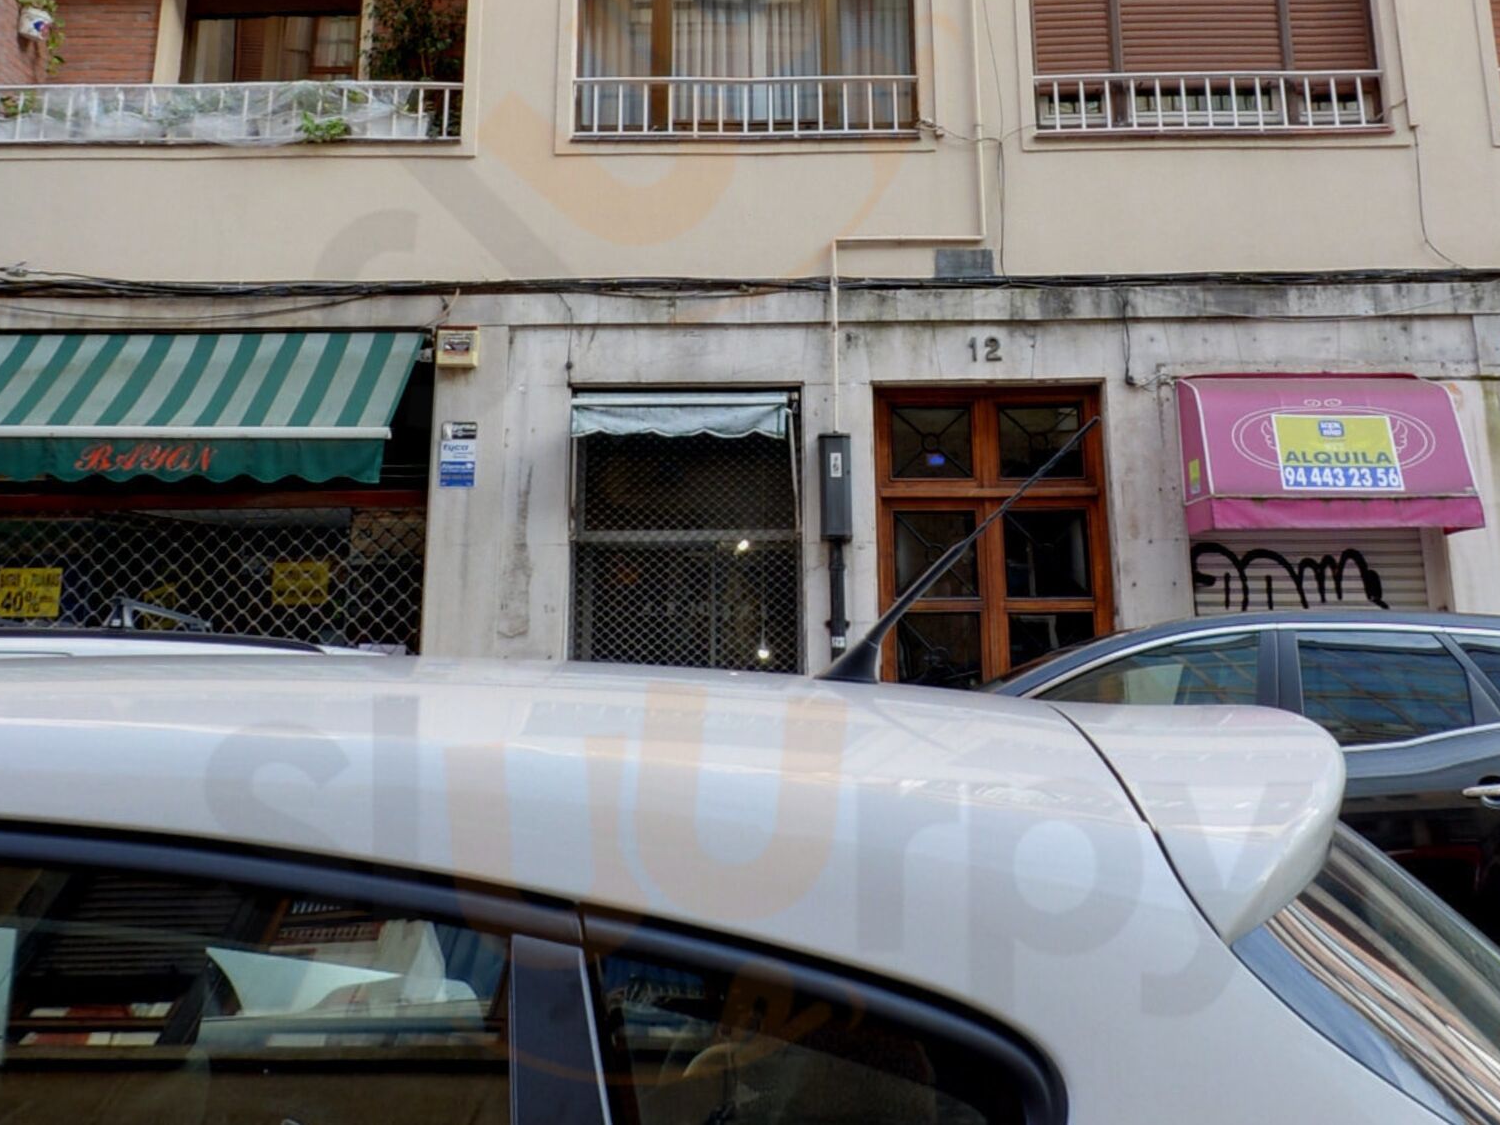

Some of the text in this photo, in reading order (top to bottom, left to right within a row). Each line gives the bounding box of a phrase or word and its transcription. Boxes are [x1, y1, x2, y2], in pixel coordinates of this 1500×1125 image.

[967, 336, 1003, 363] 12
[1285, 450, 1393, 465] ALQUILA
[1285, 466, 1400, 487] 94 443 23 56
